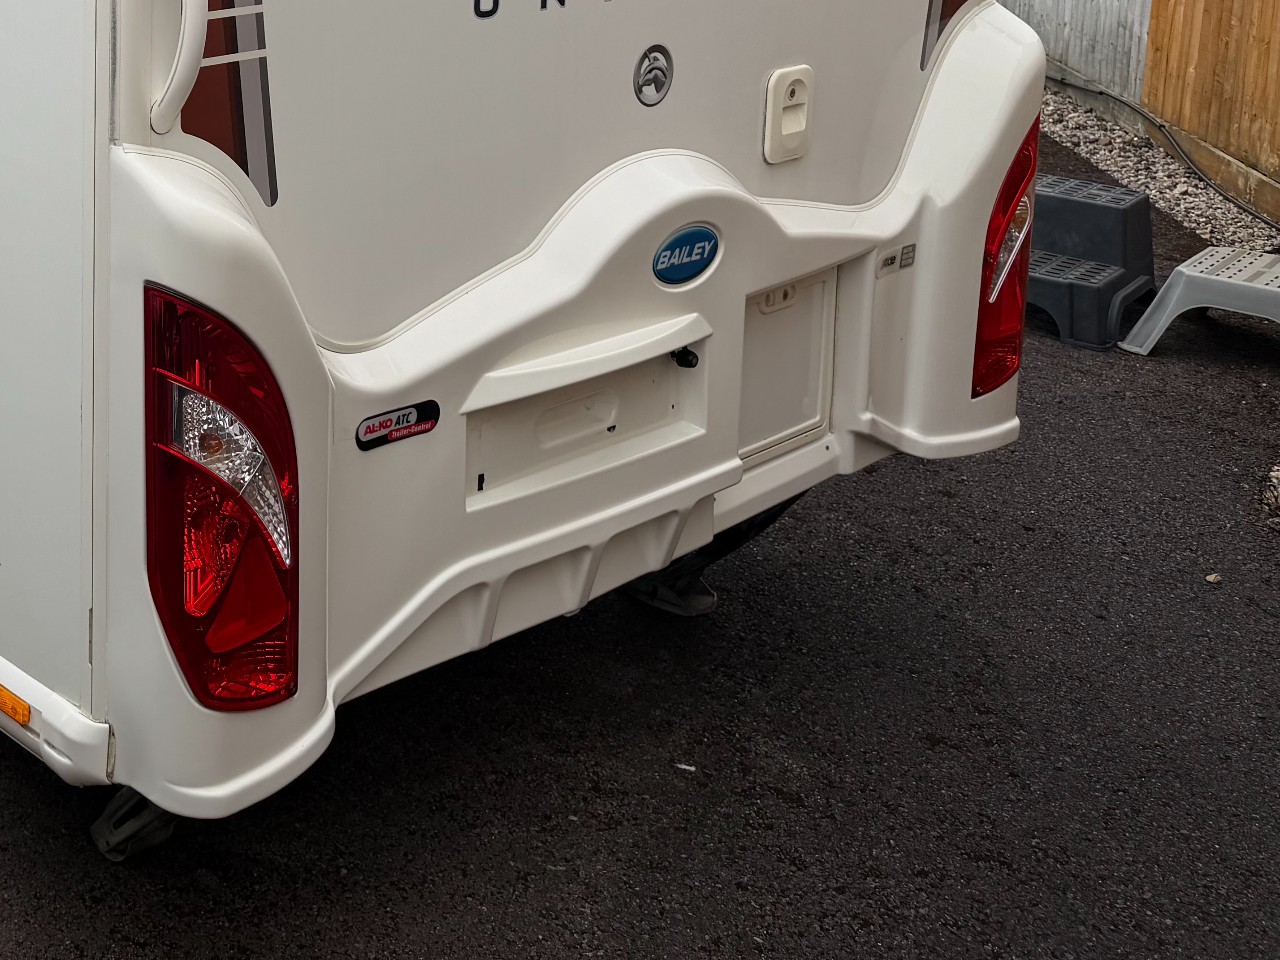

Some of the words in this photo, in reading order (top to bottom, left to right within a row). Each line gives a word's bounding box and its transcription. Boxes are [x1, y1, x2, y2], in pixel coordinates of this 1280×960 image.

[656, 239, 715, 270] BAILEY
[363, 417, 394, 437] AL-KO
[394, 411, 413, 428] ATC
[391, 421, 432, 438] Trailer-Control
